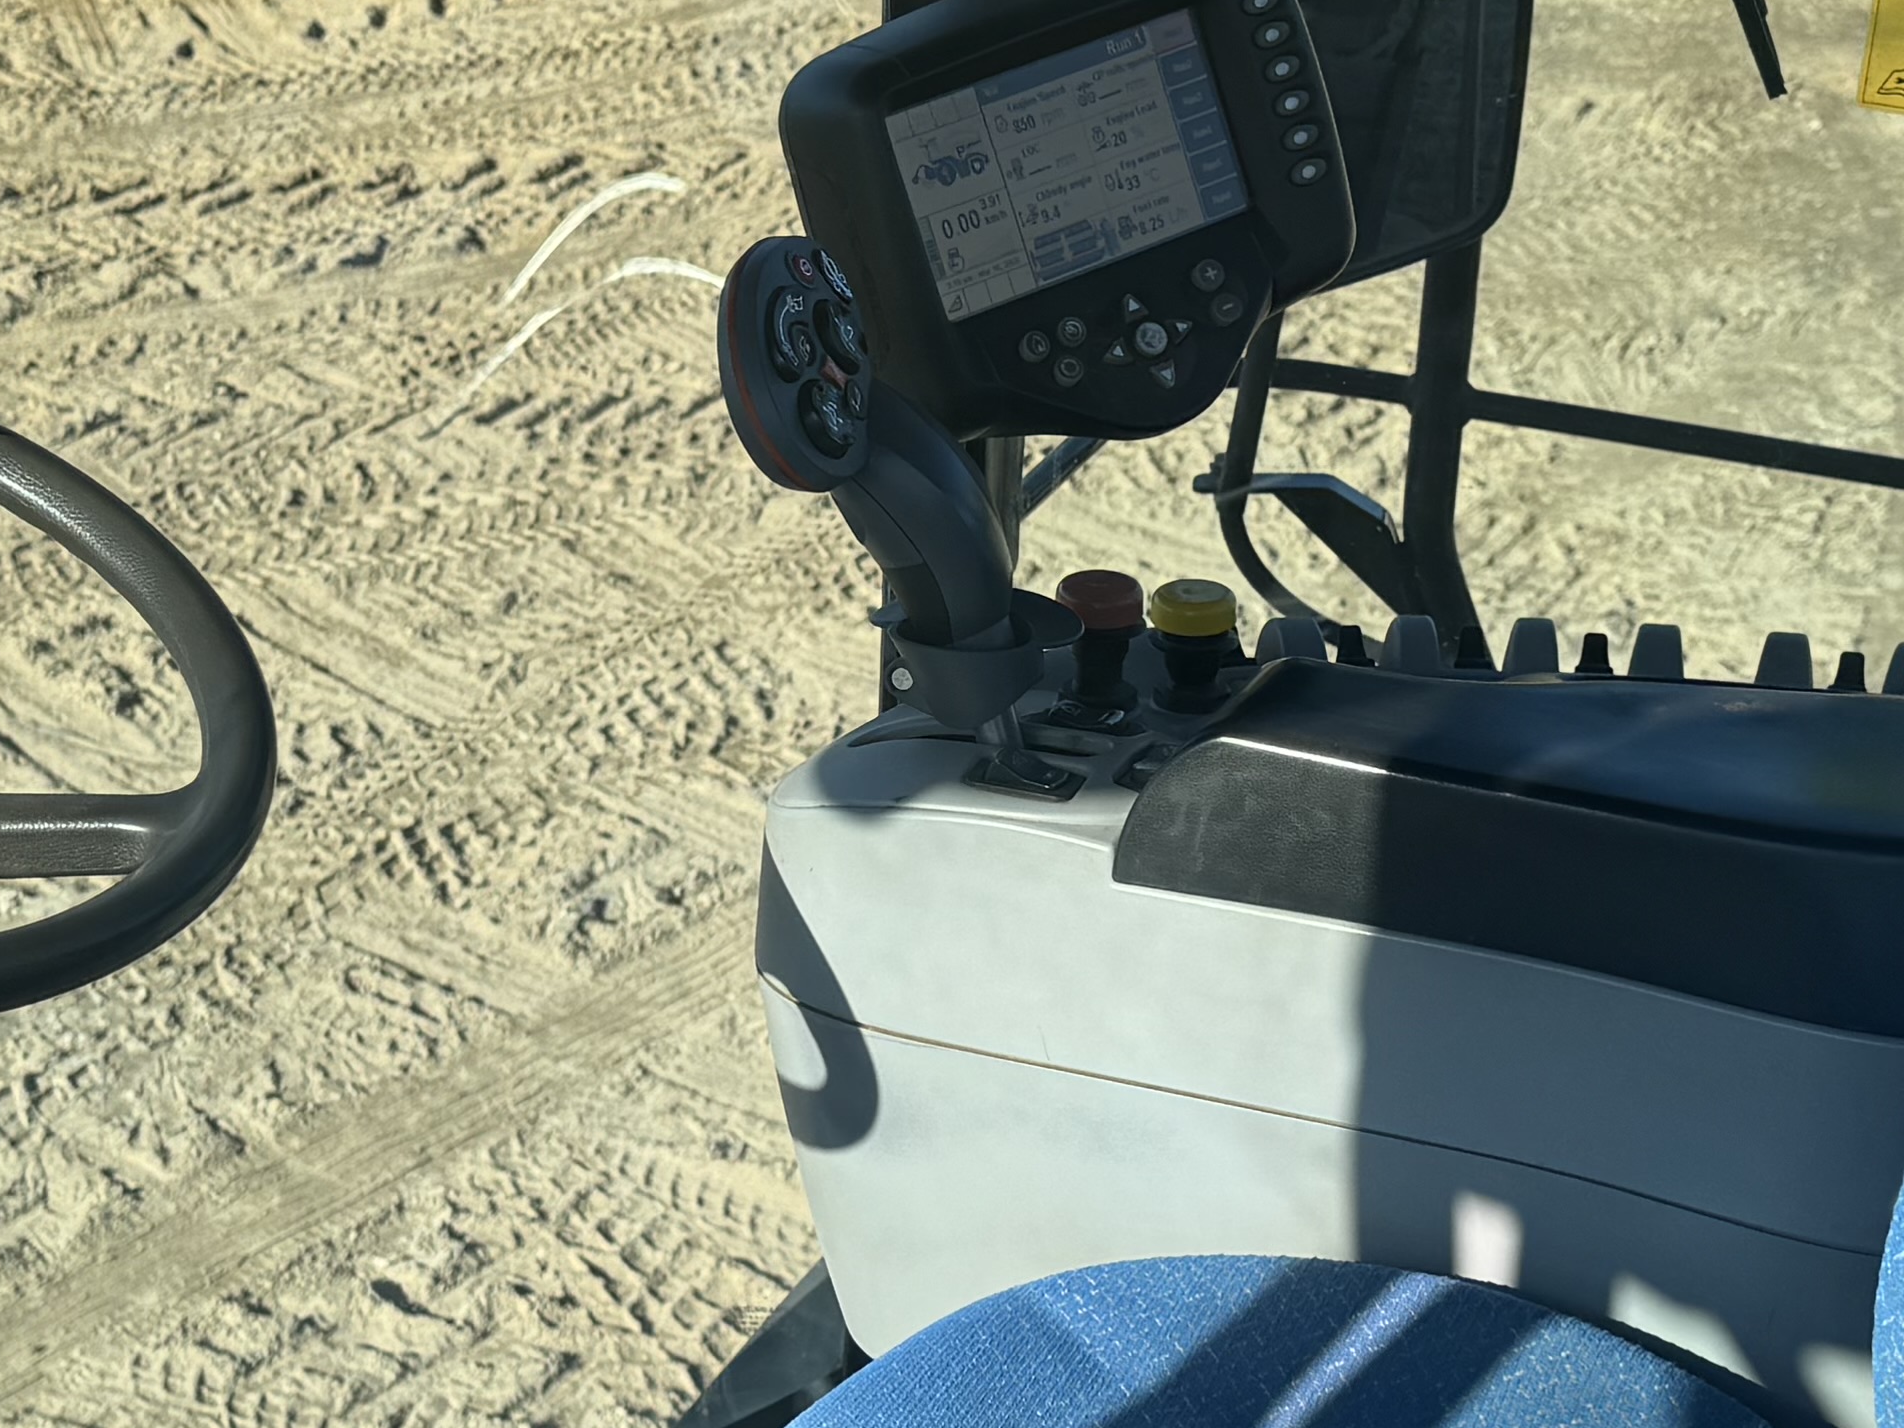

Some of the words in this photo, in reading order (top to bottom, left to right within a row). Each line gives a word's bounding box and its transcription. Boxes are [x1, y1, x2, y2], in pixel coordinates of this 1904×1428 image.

[1105, 39, 1132, 56] Run
[1110, 129, 1128, 147] 20
[1124, 174, 1141, 191] 33
[942, 209, 981, 240] 0.00
